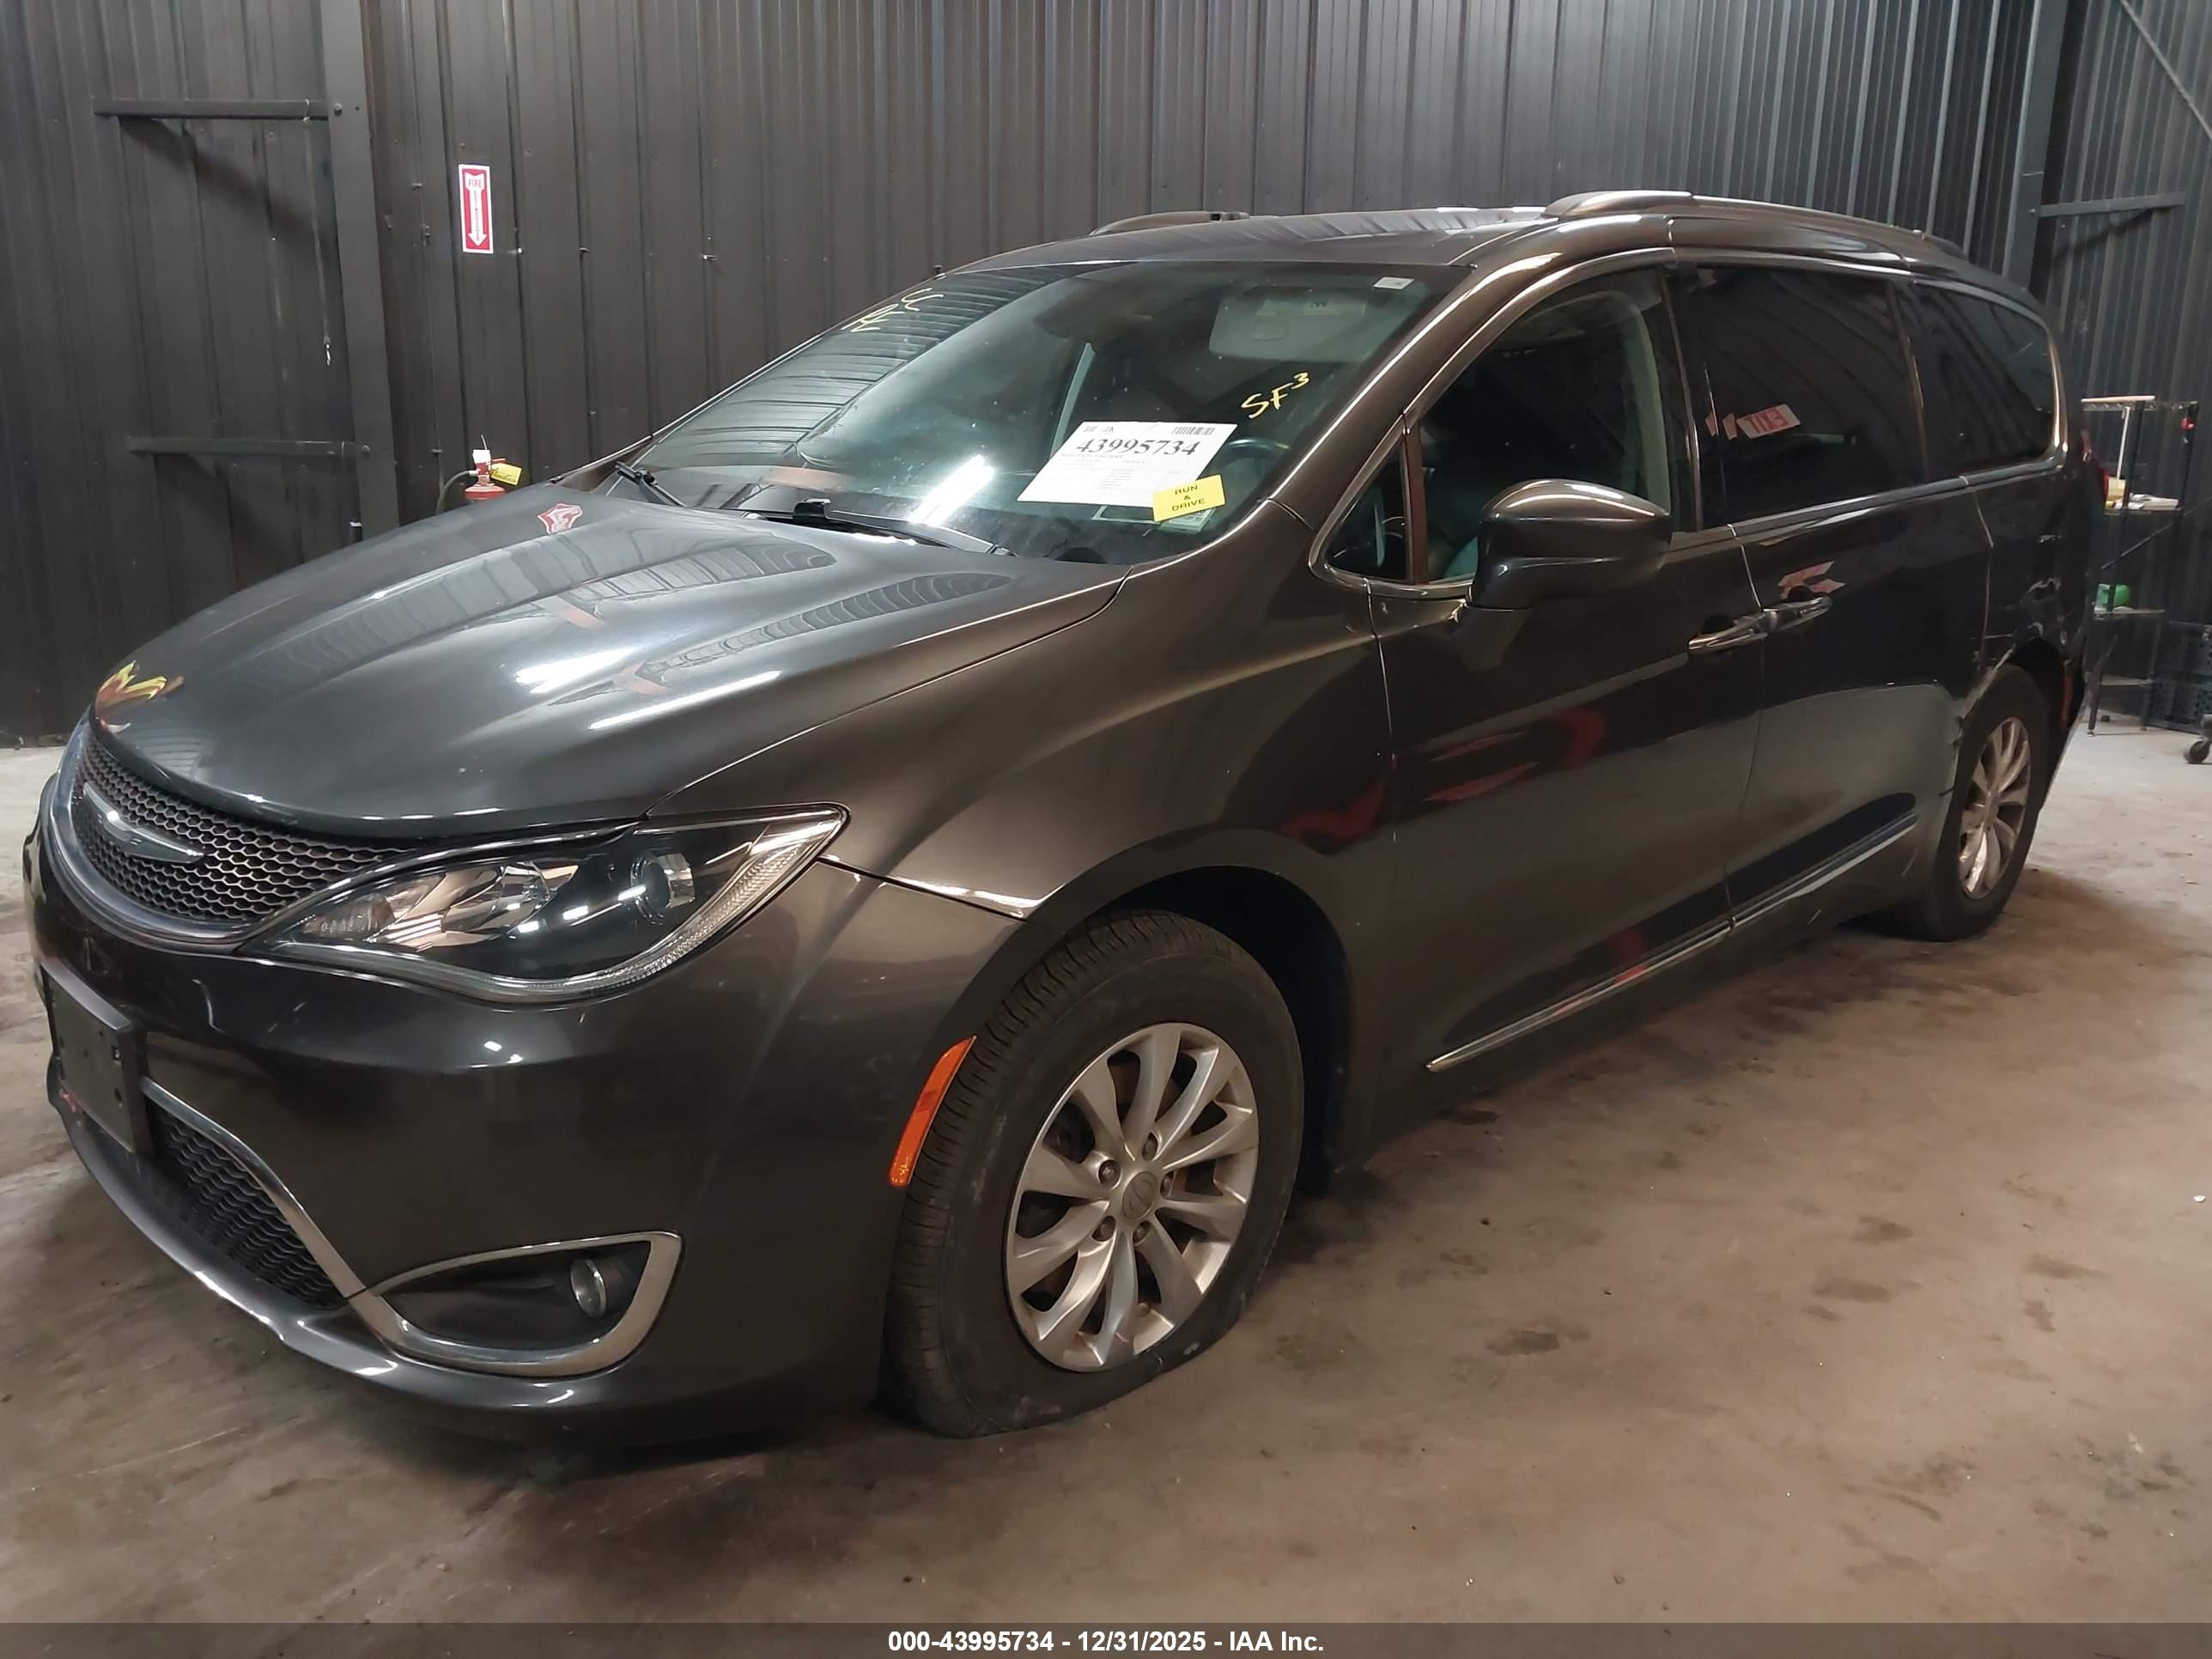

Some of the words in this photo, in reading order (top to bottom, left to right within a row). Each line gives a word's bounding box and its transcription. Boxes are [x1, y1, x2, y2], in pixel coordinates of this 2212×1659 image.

[469, 178, 483, 188] FIRE
[1075, 437, 1202, 457] 43995734
[1175, 484, 1199, 495] RUN
[1171, 498, 1206, 512] DRIVE
